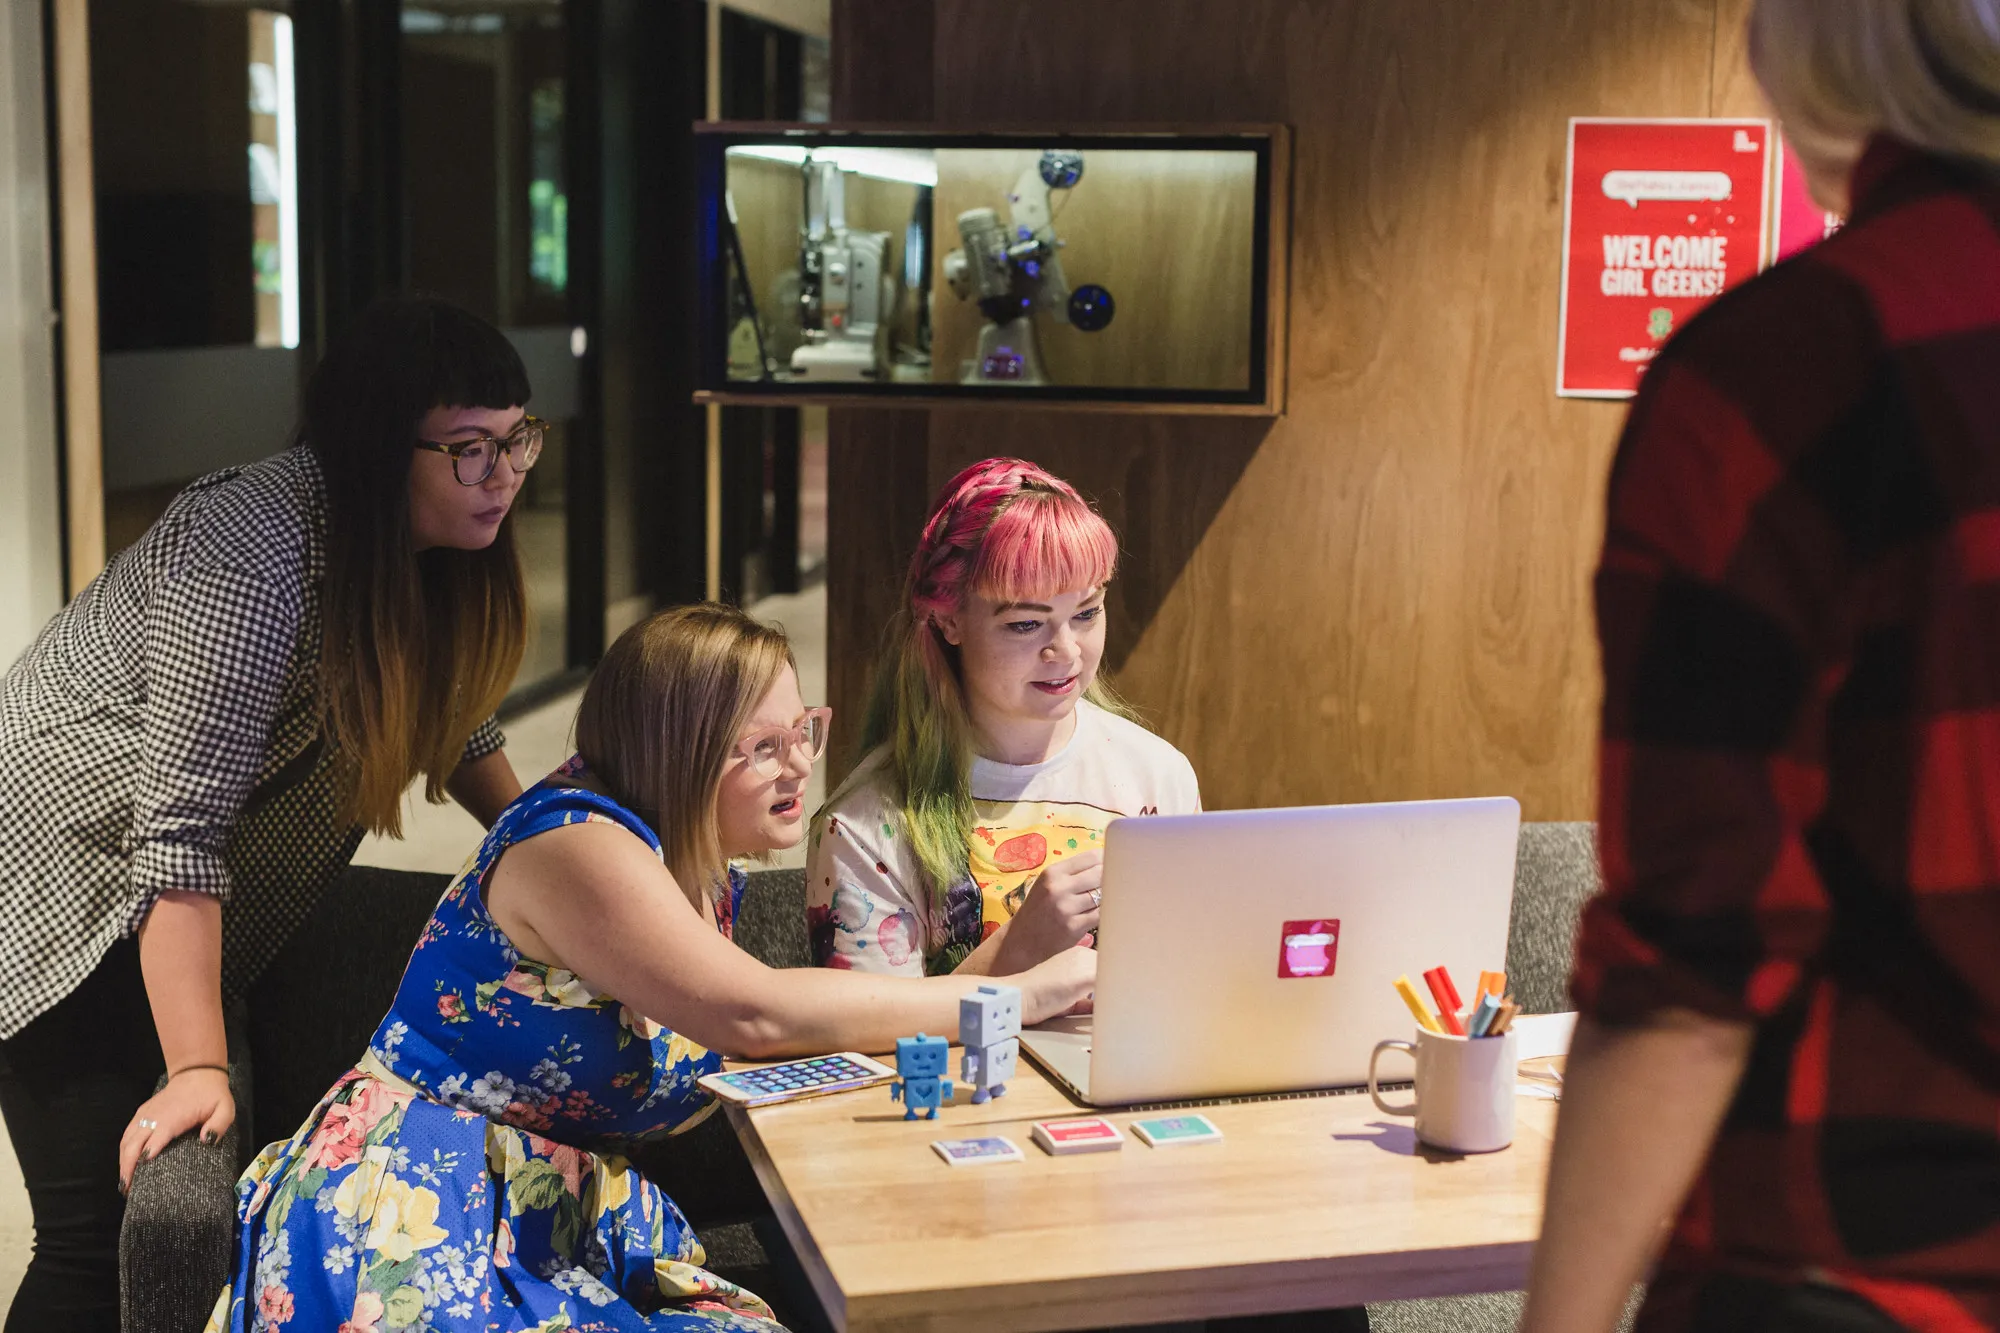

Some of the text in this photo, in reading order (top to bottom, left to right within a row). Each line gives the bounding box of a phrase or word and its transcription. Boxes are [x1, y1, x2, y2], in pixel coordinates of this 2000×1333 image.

[1602, 235, 1727, 269] WELCOME
[1600, 268, 1726, 297] GIRL GEEKS!
